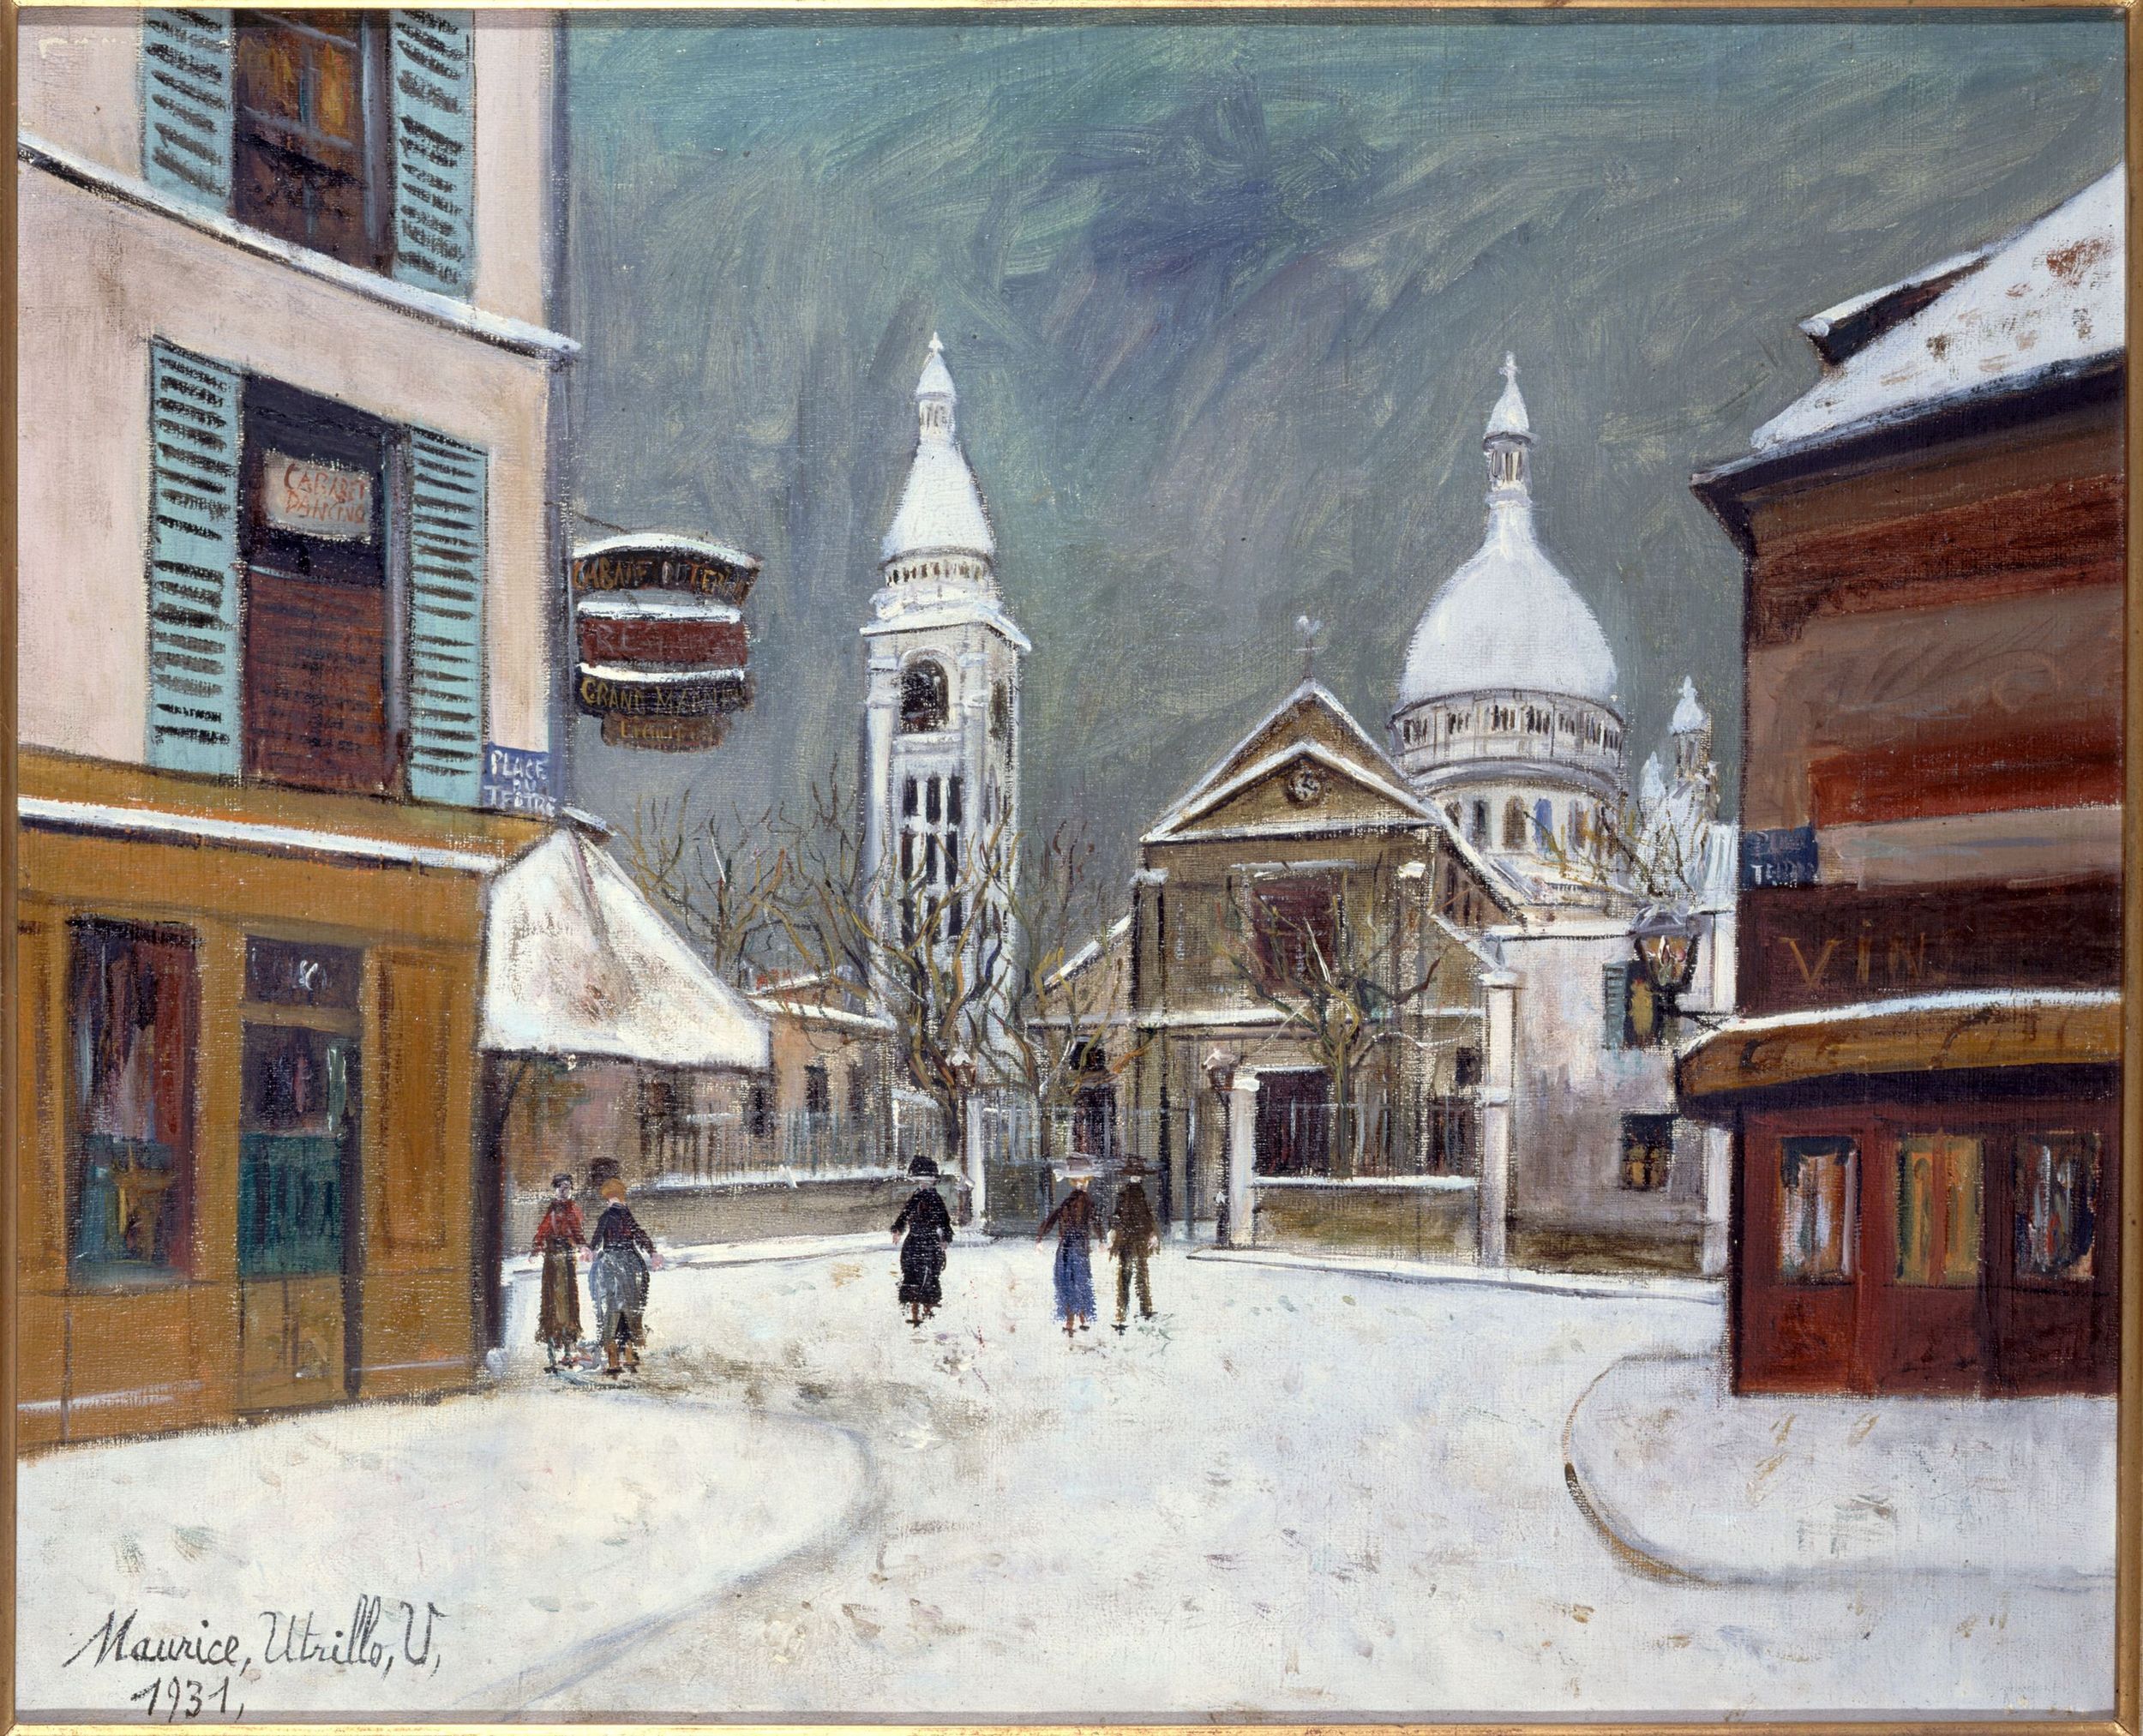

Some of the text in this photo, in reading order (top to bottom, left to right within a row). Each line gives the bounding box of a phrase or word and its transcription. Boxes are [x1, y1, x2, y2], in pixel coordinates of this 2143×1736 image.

[490, 749, 548, 781] PLACE
[62, 1608, 251, 1677] Maurice,
[259, 1593, 394, 1680] Utrillo,
[130, 1675, 244, 1723] 1931,
